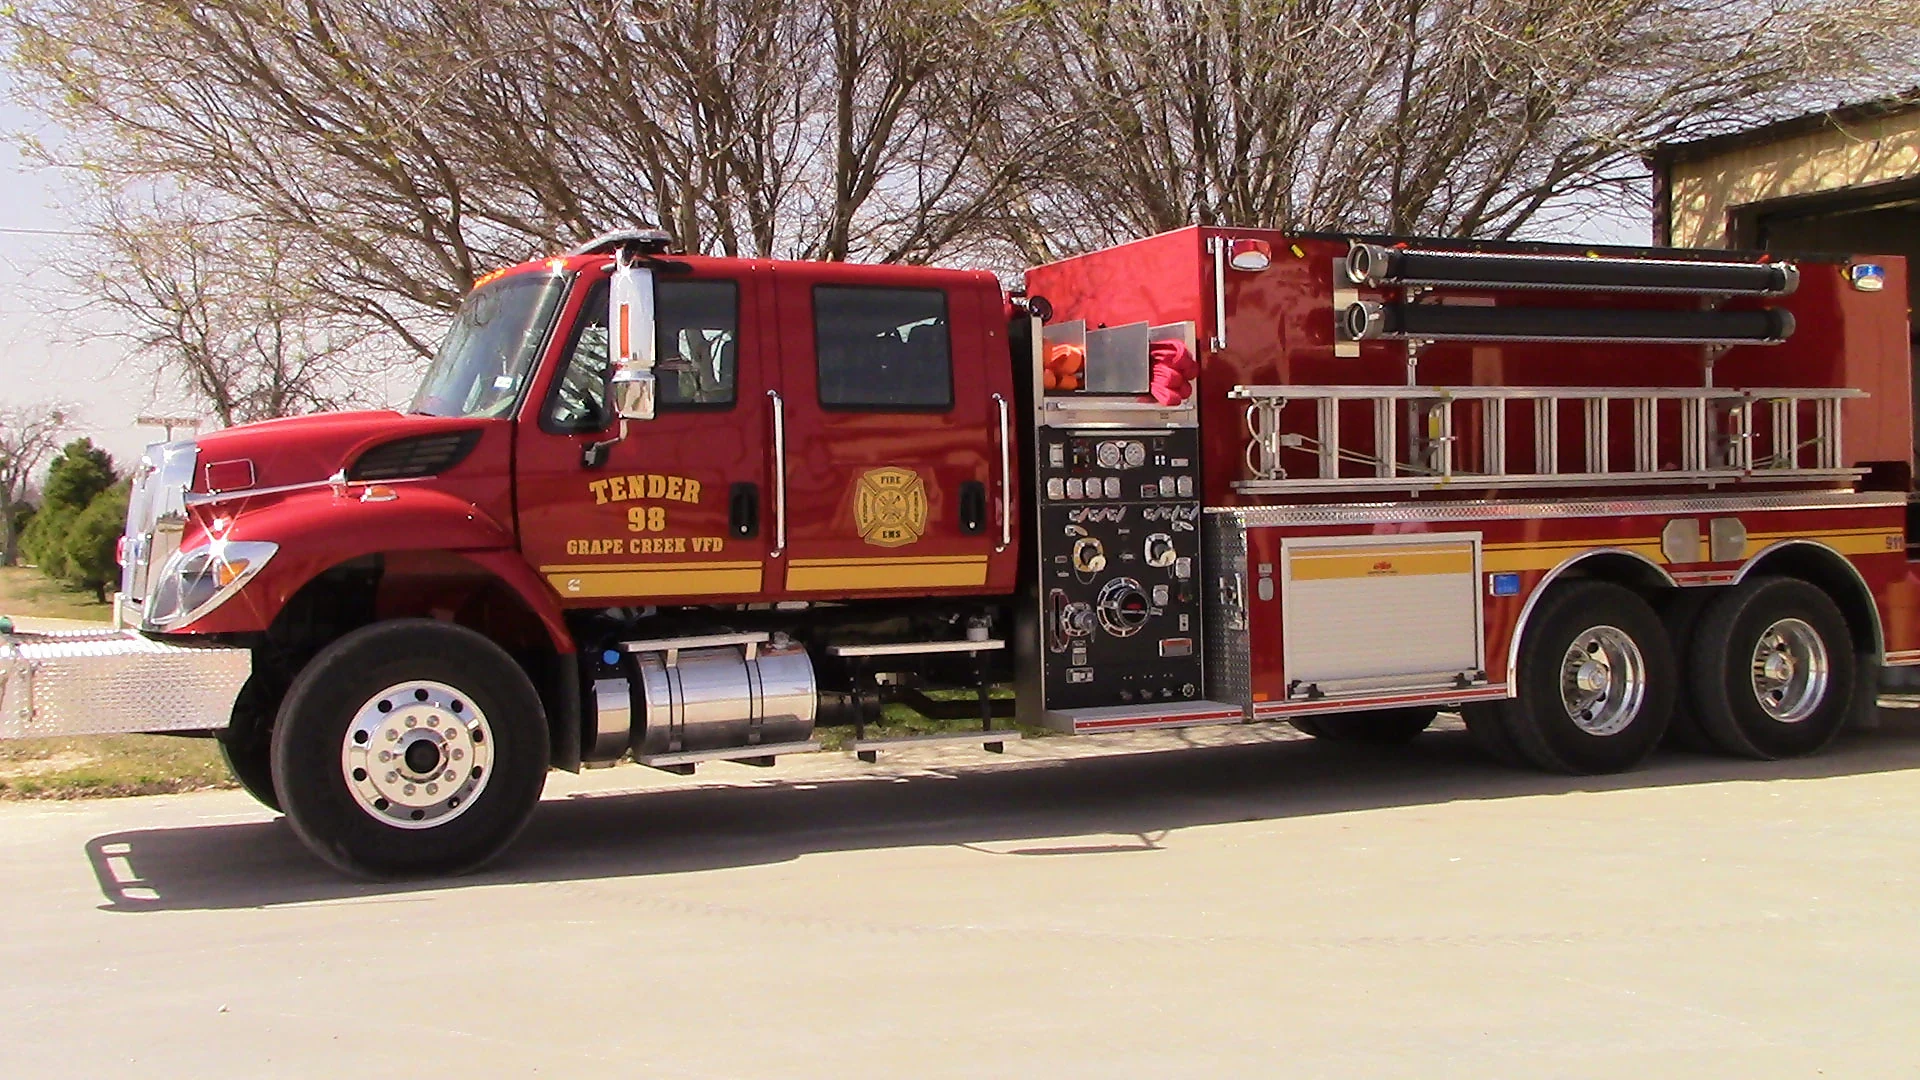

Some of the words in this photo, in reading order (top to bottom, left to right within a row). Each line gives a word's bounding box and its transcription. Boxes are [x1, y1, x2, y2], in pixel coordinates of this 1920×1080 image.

[881, 475, 901, 484] FIRE
[589, 474, 701, 505] TENDER
[628, 506, 666, 532] 98
[882, 530, 901, 539] EMS
[566, 539, 624, 555] GRAPE
[629, 538, 686, 554] CREEK
[692, 537, 724, 552] VFD
